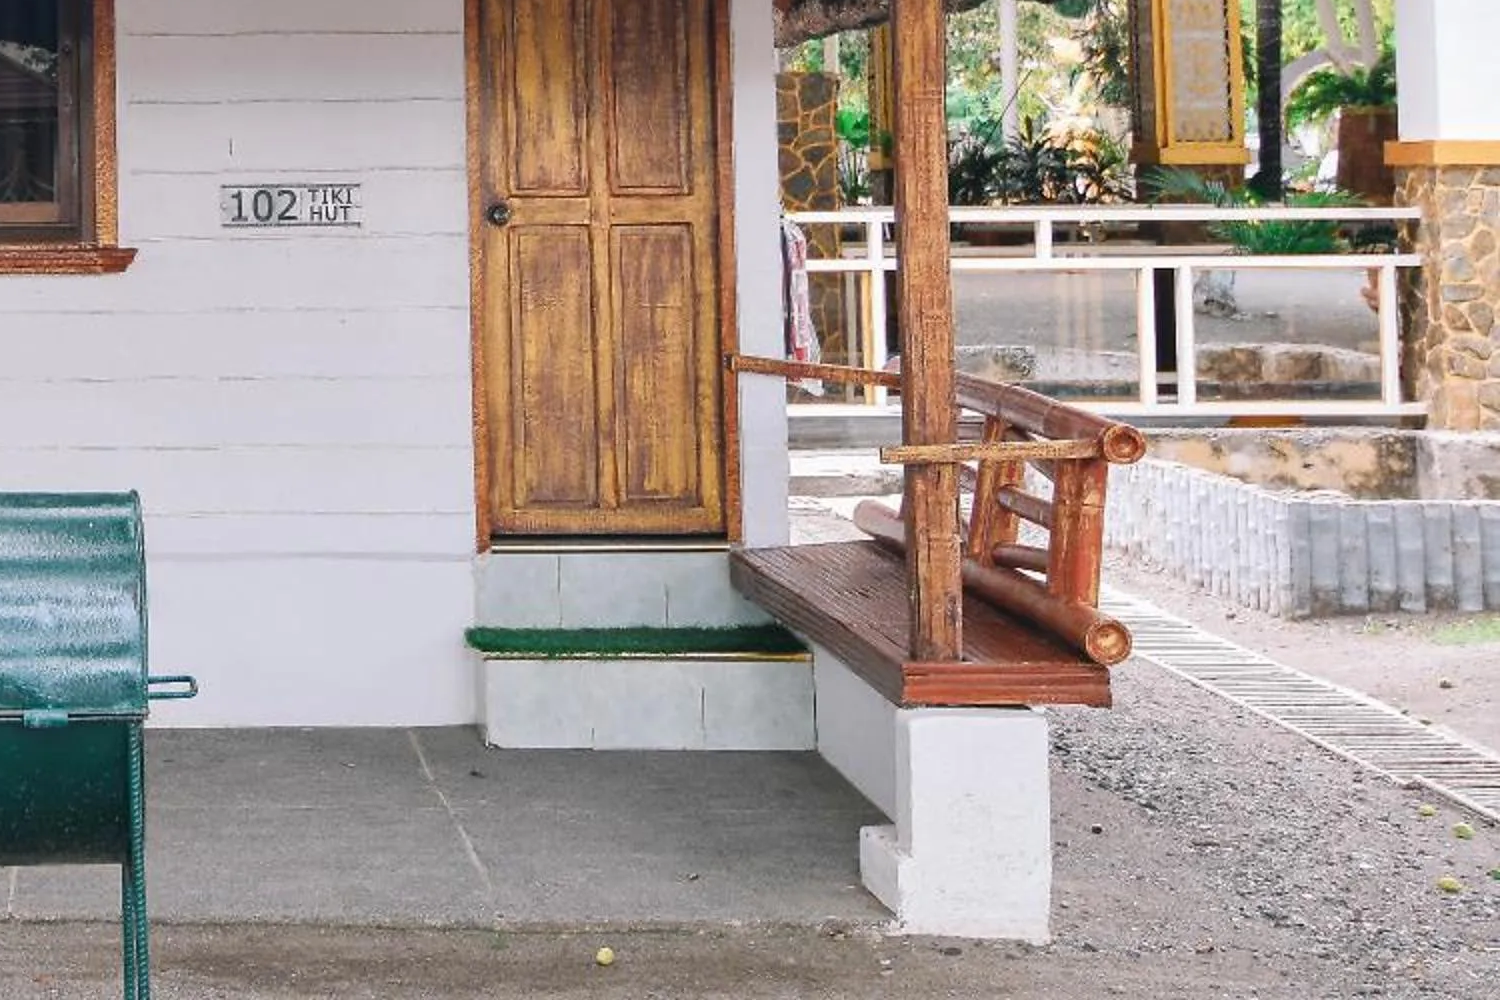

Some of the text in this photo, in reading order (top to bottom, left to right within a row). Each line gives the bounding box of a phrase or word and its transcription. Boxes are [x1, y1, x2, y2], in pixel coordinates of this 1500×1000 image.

[308, 188, 353, 205] TIKI
[231, 189, 298, 222] 102
[309, 205, 351, 222] HUT
